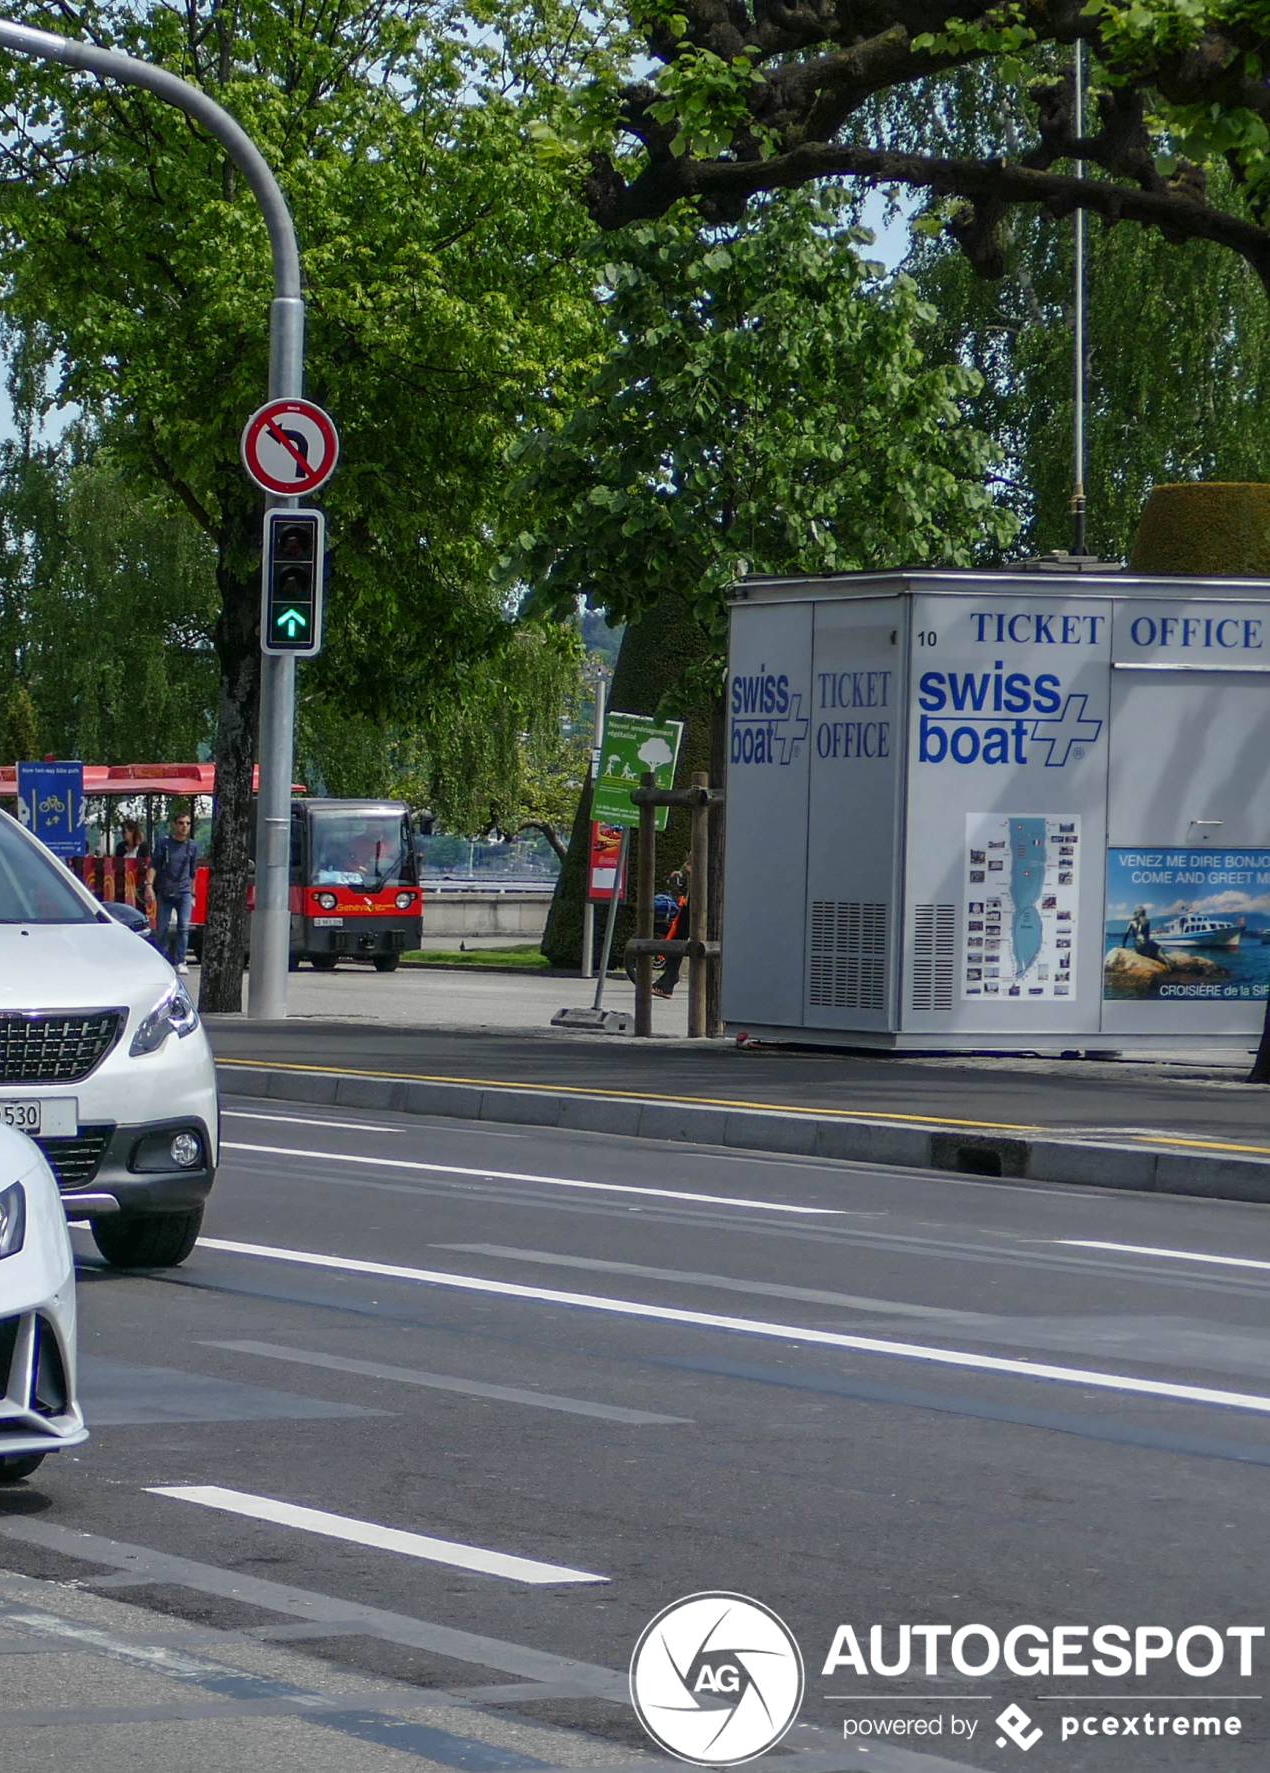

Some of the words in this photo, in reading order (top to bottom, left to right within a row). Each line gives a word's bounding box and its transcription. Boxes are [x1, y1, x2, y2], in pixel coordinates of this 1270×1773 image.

[918, 630, 937, 647] 10
[970, 612, 1106, 645] TICKET
[1130, 616, 1264, 649] OFFICE
[731, 663, 790, 714] swiss
[818, 671, 892, 709] TICKET
[918, 660, 1062, 714] swiss
[731, 716, 774, 765] boat
[817, 721, 890, 759] OFFICE
[918, 714, 1028, 765] boat
[1119, 854, 1163, 867] VENEZ
[1166, 855, 1187, 868] ME
[1190, 855, 1222, 868] DIRE
[1132, 871, 1173, 884] COME
[1176, 871, 1205, 884] AND
[1208, 871, 1253, 884] GREET
[1159, 982, 1222, 997] CROISIÈRE
[1224, 985, 1238, 996] de
[1241, 985, 1250, 996] la
[4, 1105, 38, 1126] 530
